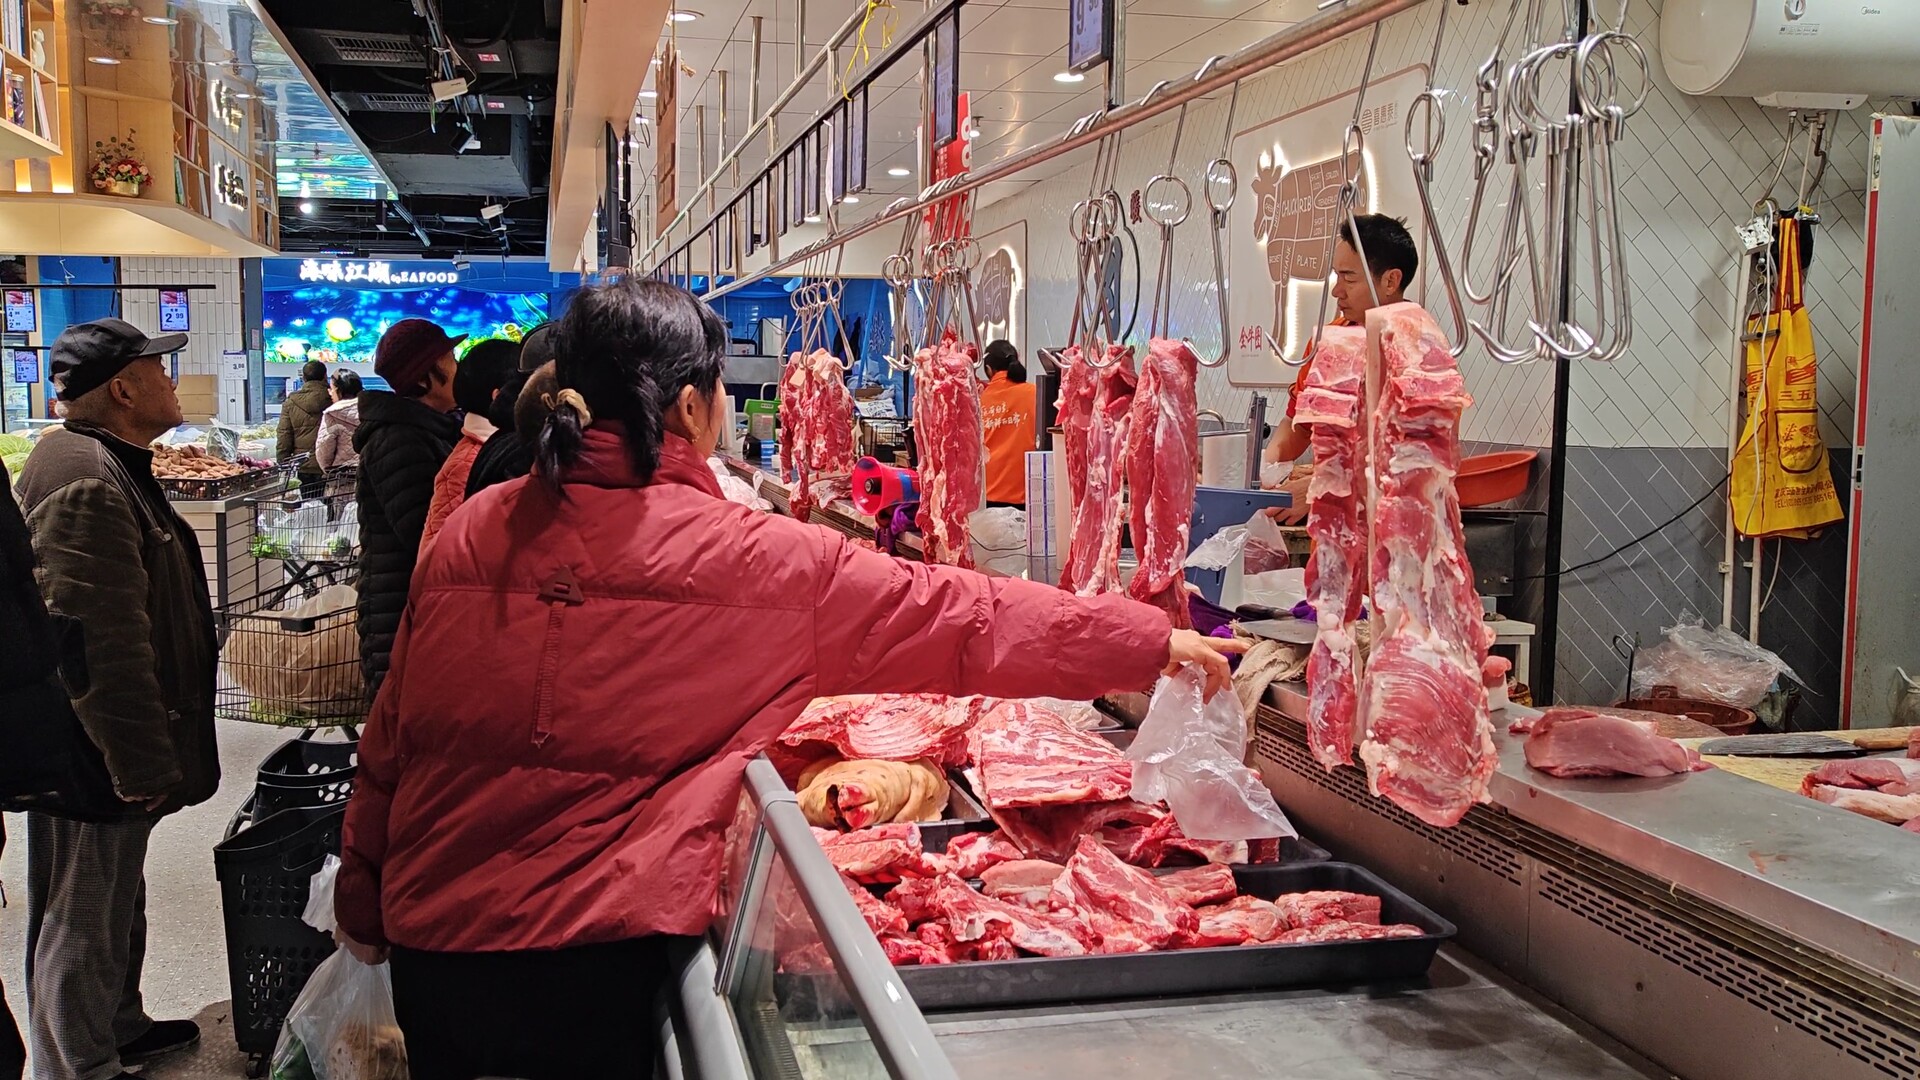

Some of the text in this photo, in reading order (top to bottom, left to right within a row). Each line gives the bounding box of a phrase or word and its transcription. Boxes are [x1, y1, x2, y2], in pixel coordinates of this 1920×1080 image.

[1300, 195, 1312, 213] RIB
[1282, 245, 1292, 280] SHANK
[1296, 254, 1317, 269] PLATE
